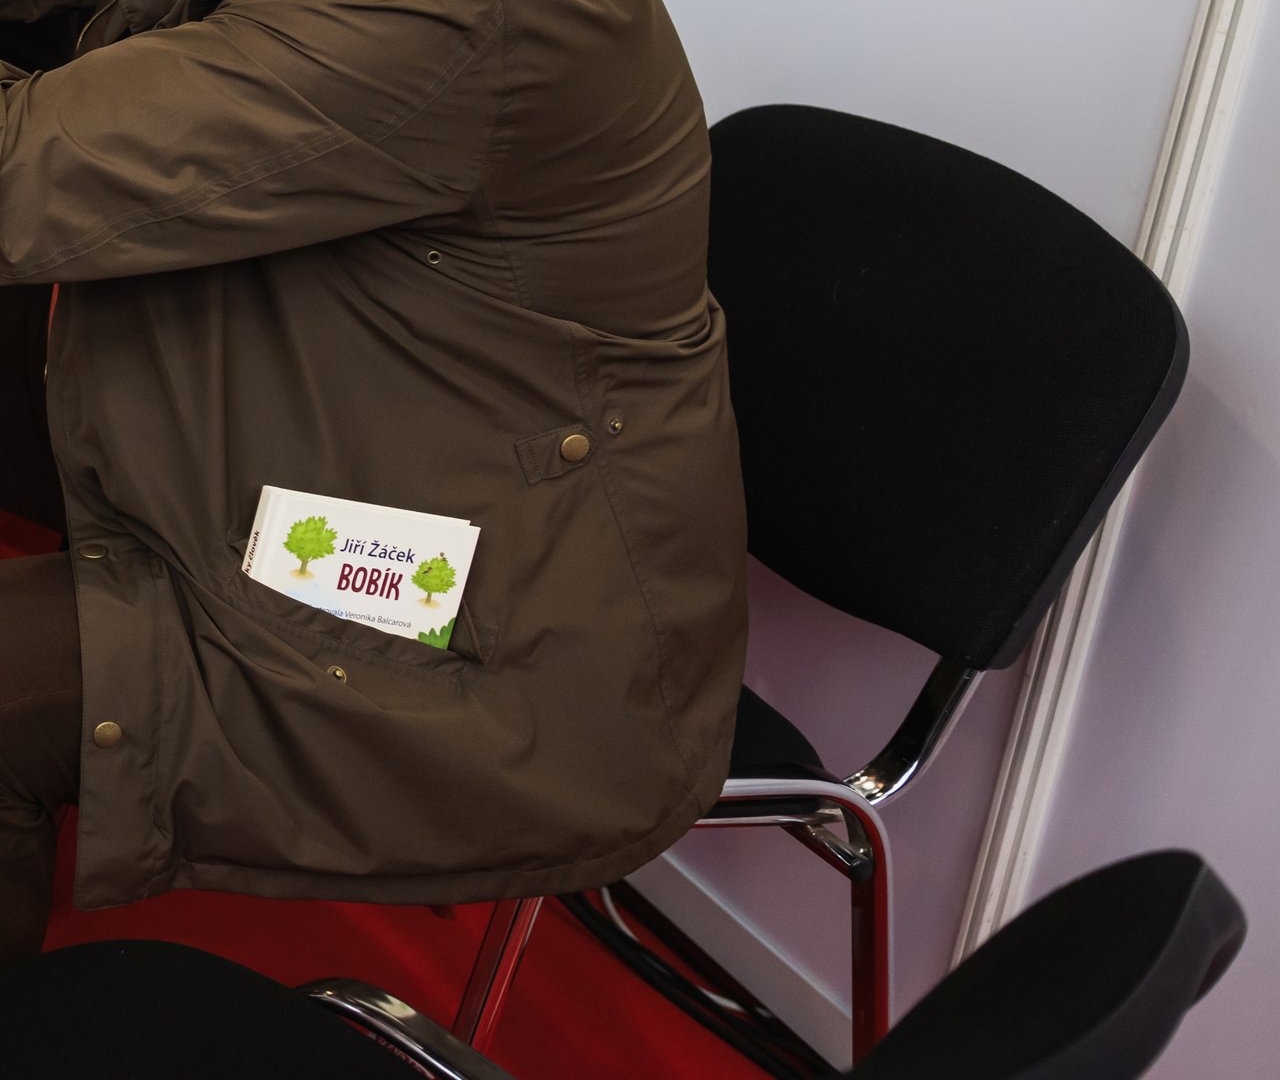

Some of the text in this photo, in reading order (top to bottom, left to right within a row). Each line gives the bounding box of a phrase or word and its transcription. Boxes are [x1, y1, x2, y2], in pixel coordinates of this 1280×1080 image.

[340, 538, 416, 564] Jiří Žáček
[336, 563, 404, 601] BOBÍK
[344, 610, 376, 623] Veronika
